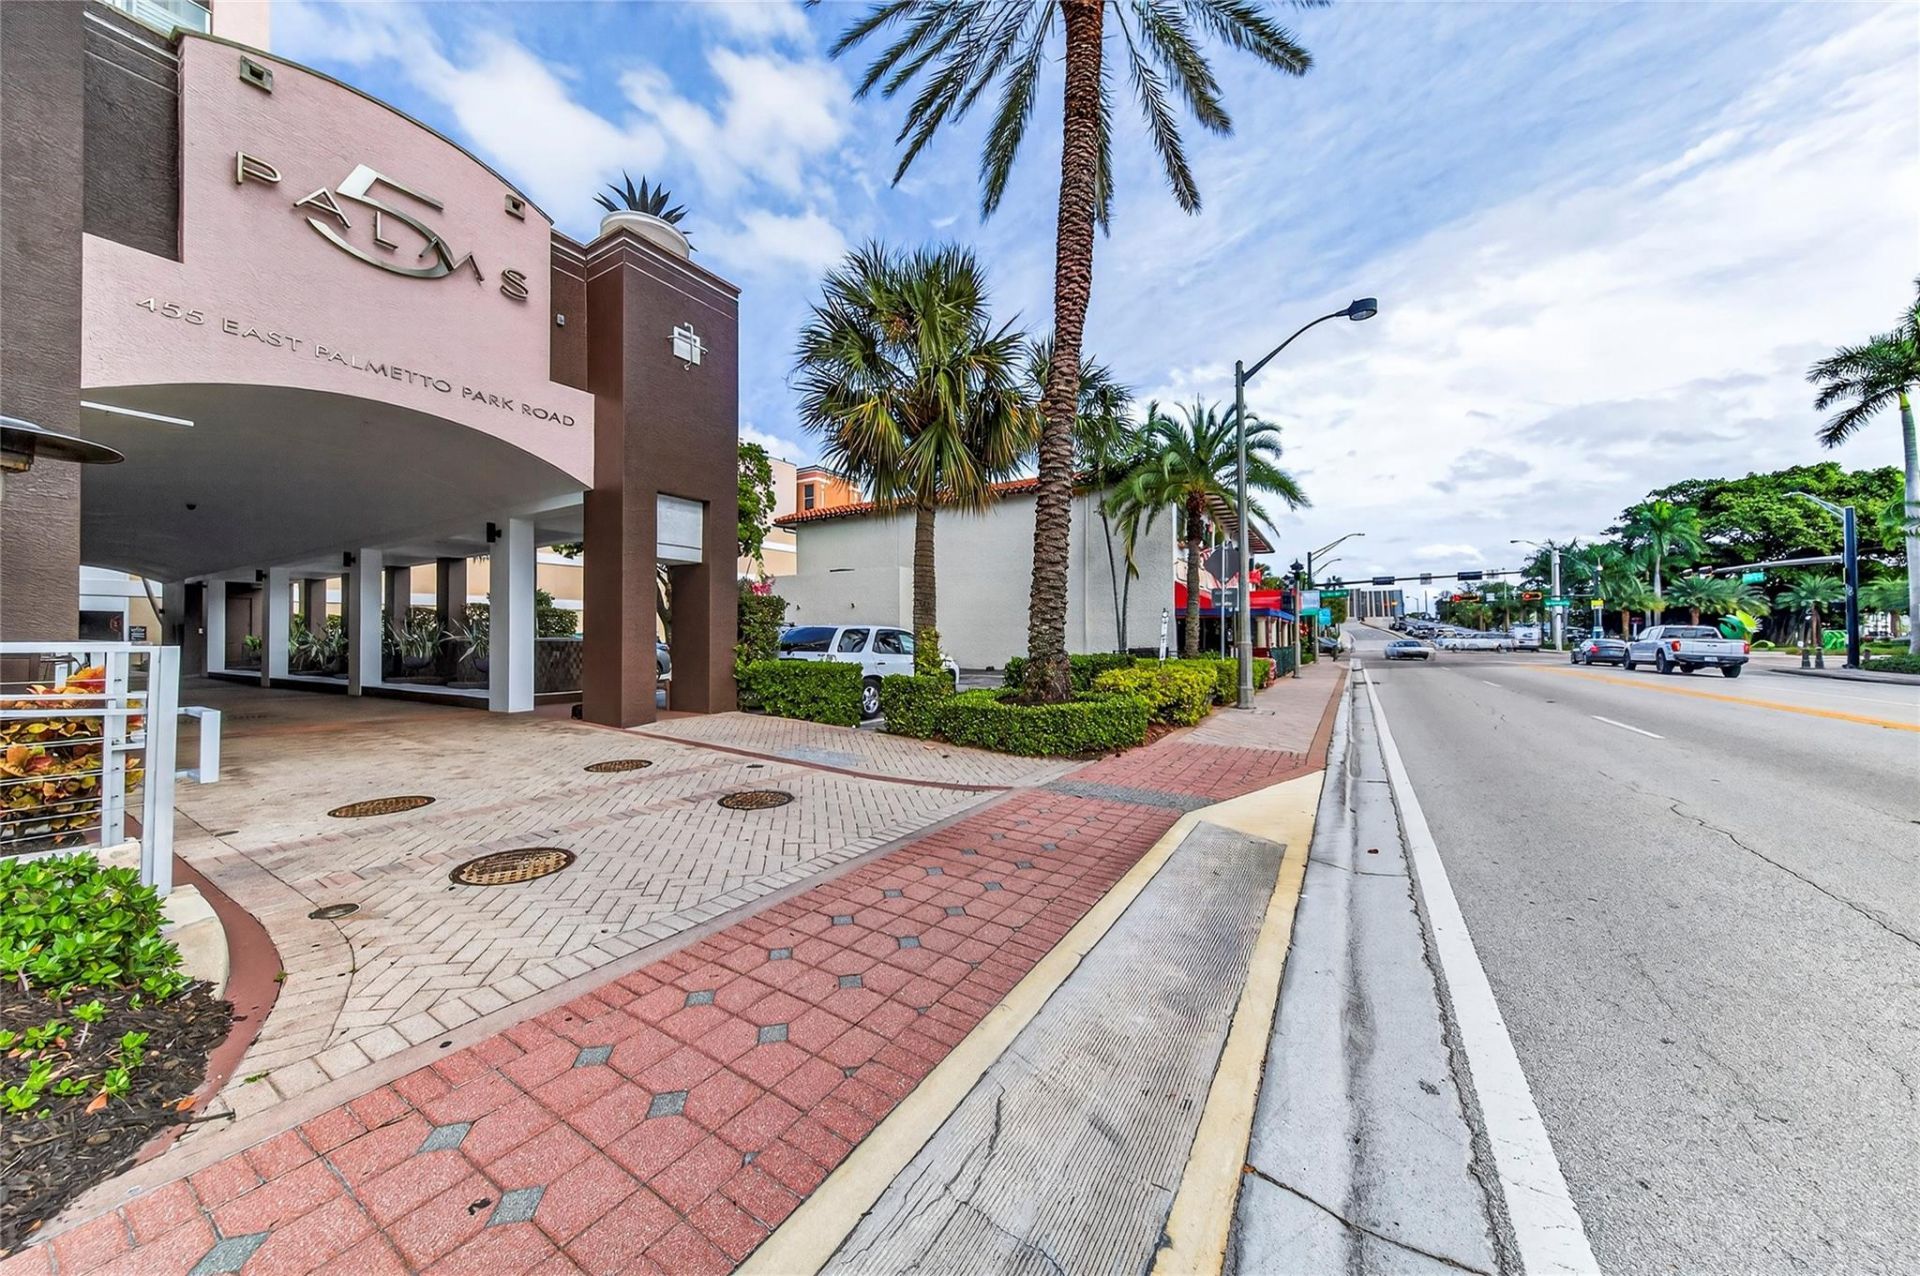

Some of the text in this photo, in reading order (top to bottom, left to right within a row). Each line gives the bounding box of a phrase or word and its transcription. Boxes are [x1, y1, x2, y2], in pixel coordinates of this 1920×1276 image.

[236, 151, 529, 300] PALMS
[305, 163, 456, 280] 5
[136, 297, 575, 427] 455 EAST PALMETTO PARK ROAD
